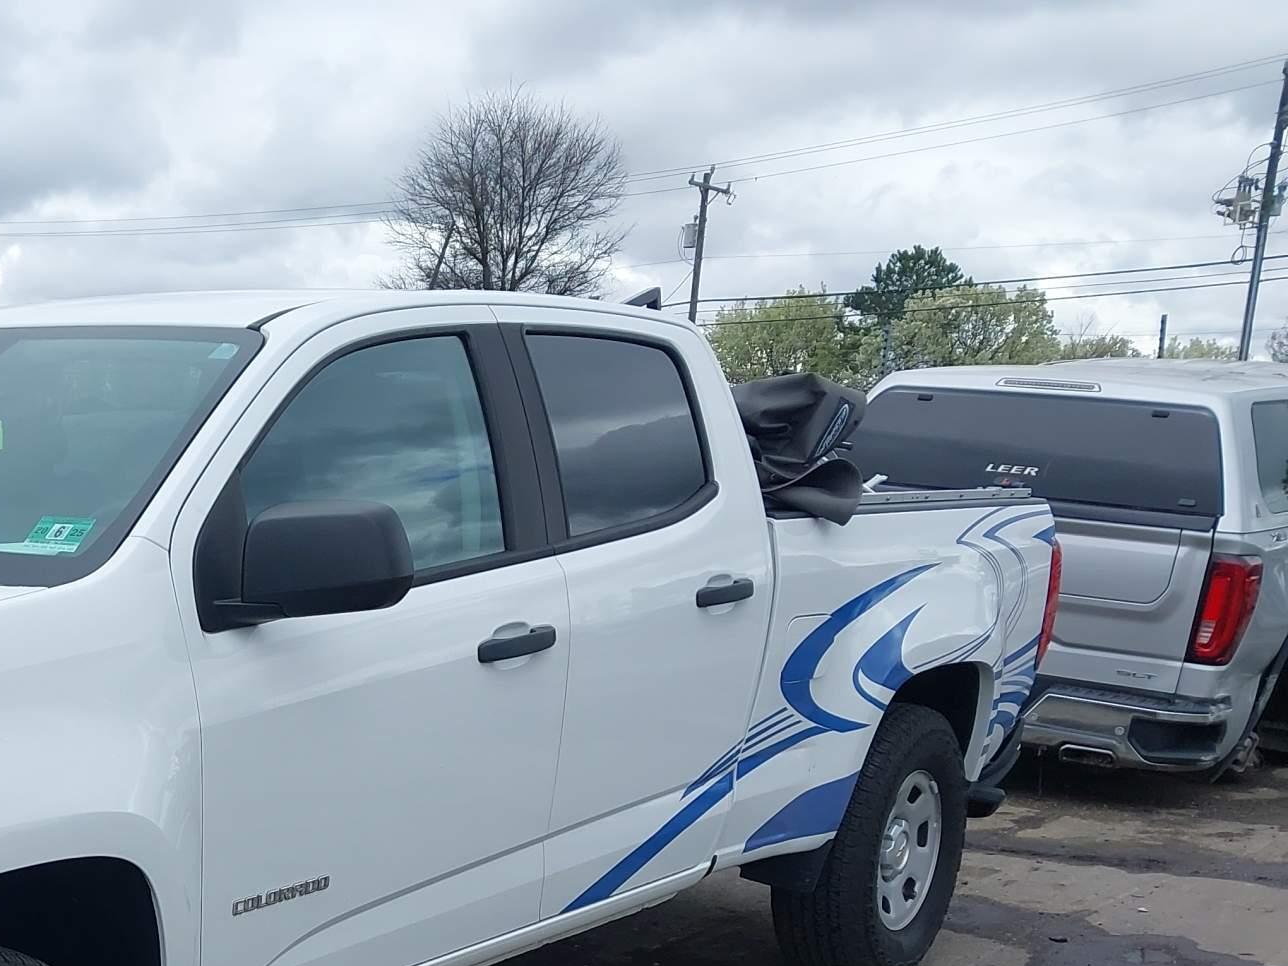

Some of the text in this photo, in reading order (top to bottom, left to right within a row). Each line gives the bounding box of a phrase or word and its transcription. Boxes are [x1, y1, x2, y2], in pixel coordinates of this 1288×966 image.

[985, 463, 1040, 477] LEER
[53, 525, 66, 538] 6
[70, 528, 87, 537] 25
[232, 875, 330, 916] COLORADO
